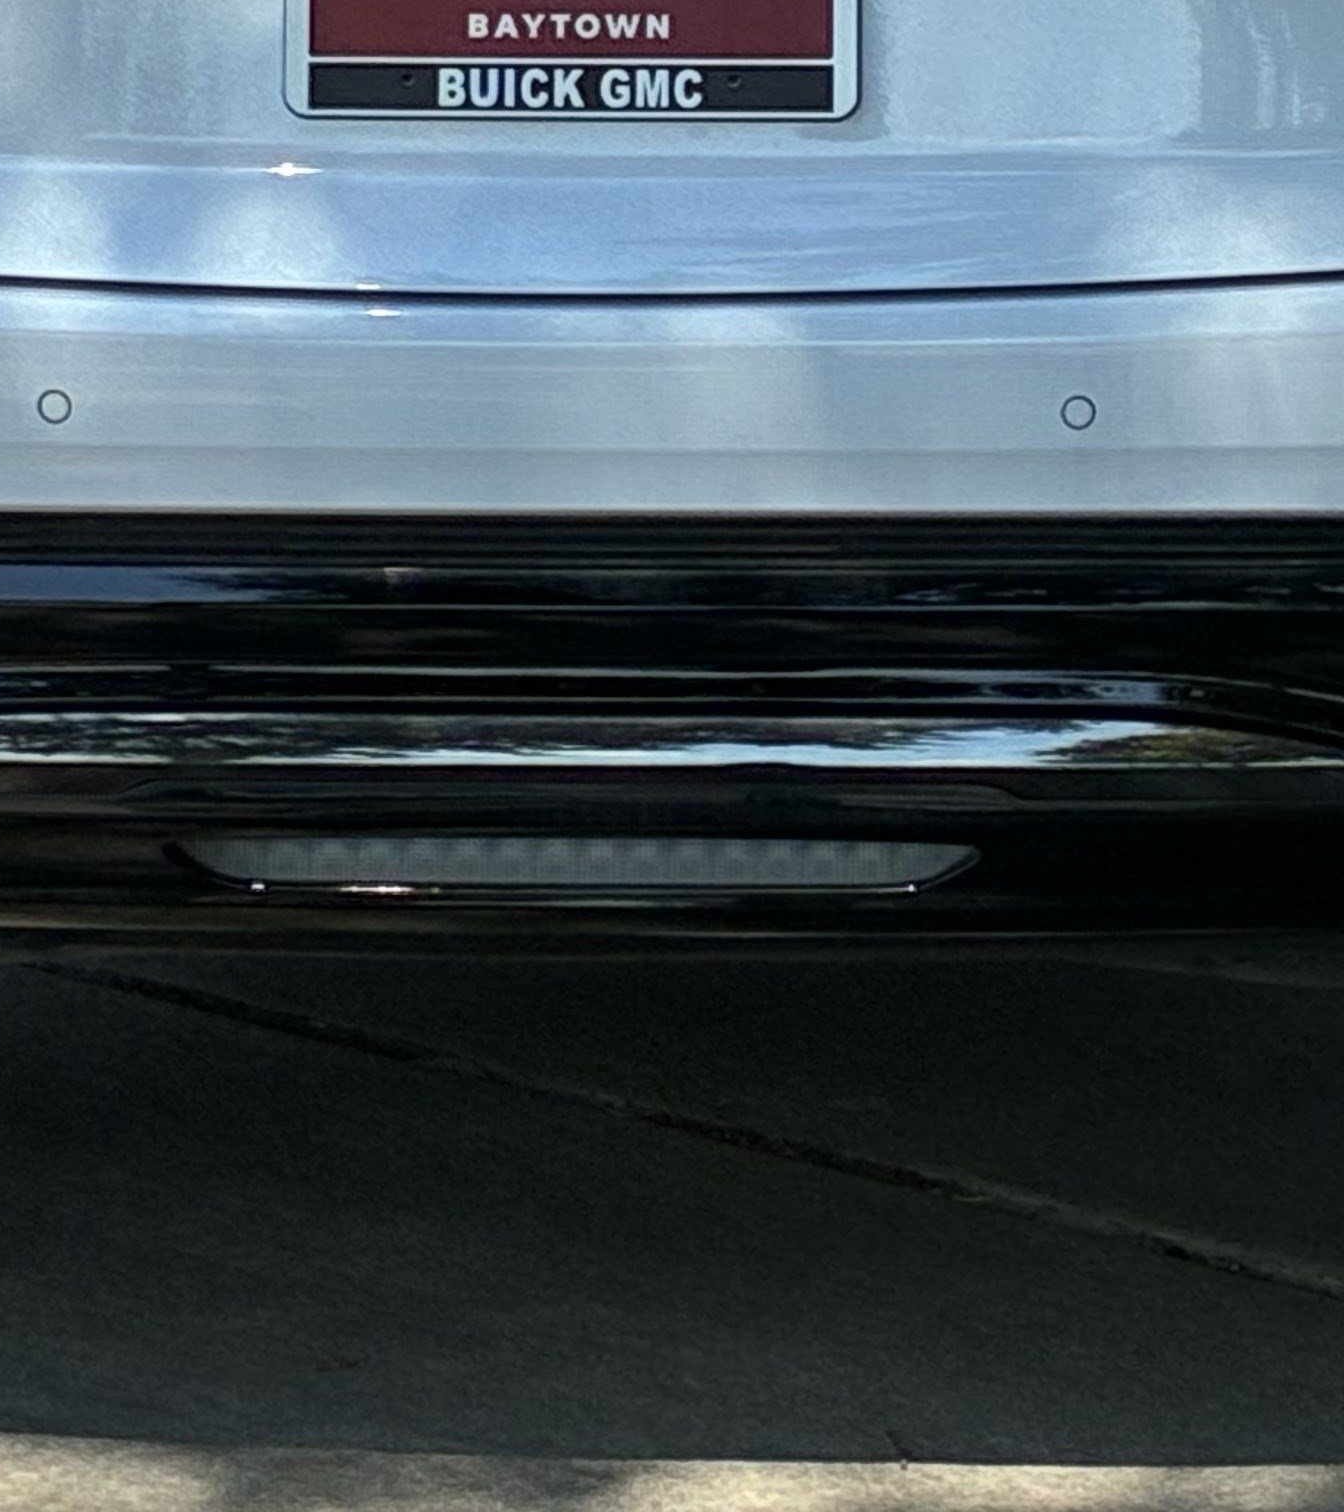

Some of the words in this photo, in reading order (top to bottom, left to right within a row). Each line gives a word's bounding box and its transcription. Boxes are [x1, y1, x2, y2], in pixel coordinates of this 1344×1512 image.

[468, 13, 670, 40] BAYTOWN
[438, 69, 584, 107] BUICK
[601, 70, 703, 109] GMC
